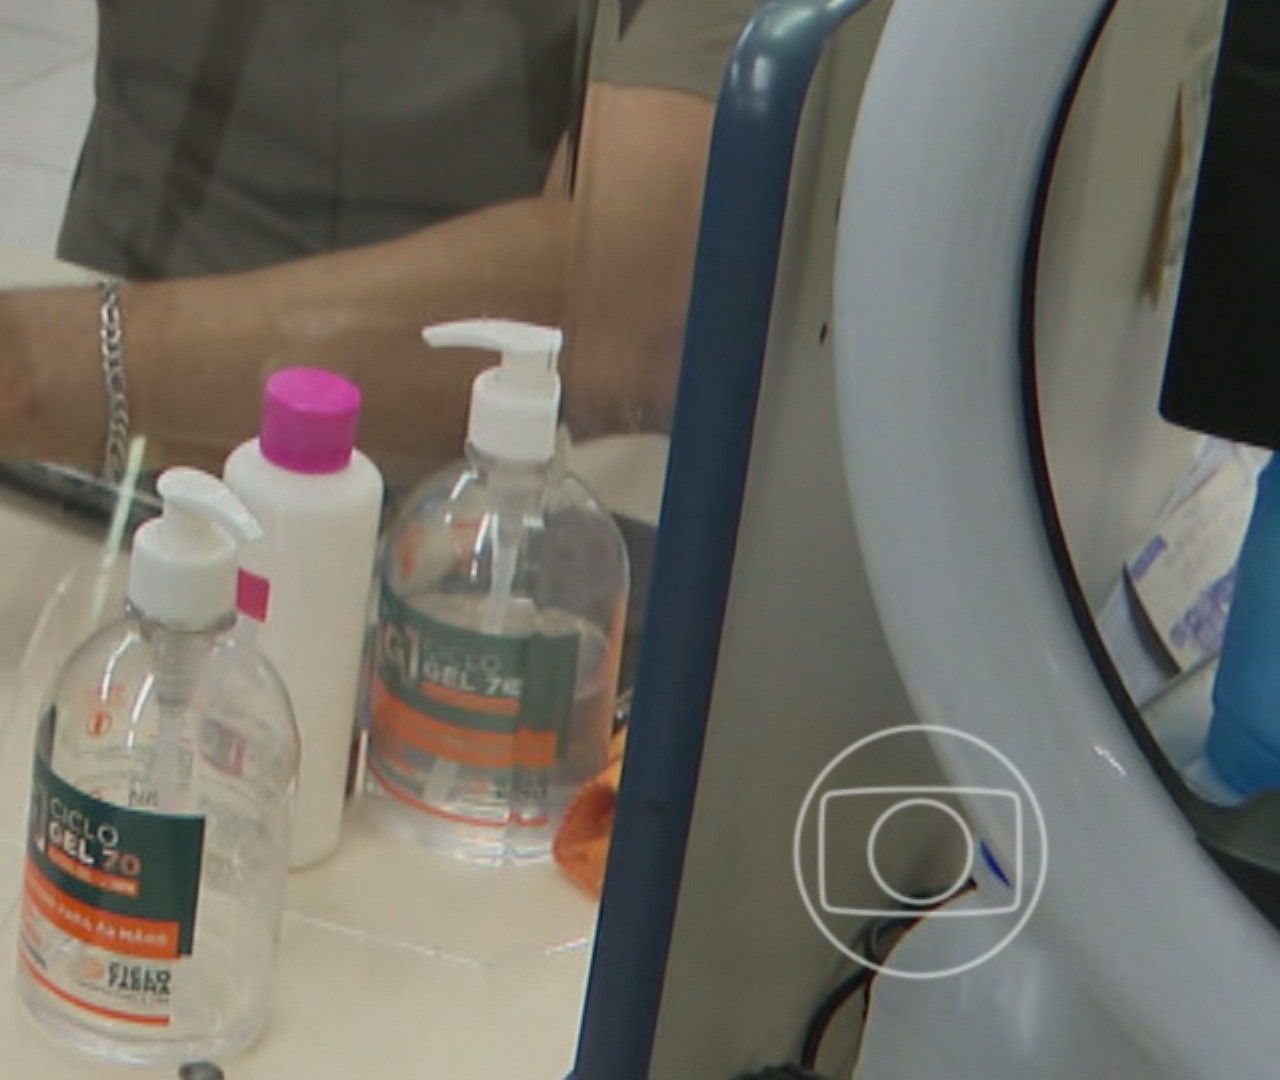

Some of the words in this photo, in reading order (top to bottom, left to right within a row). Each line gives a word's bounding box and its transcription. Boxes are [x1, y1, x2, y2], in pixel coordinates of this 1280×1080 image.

[50, 798, 119, 847] CICLO
[49, 821, 95, 865] GEL
[102, 847, 142, 877] 70
